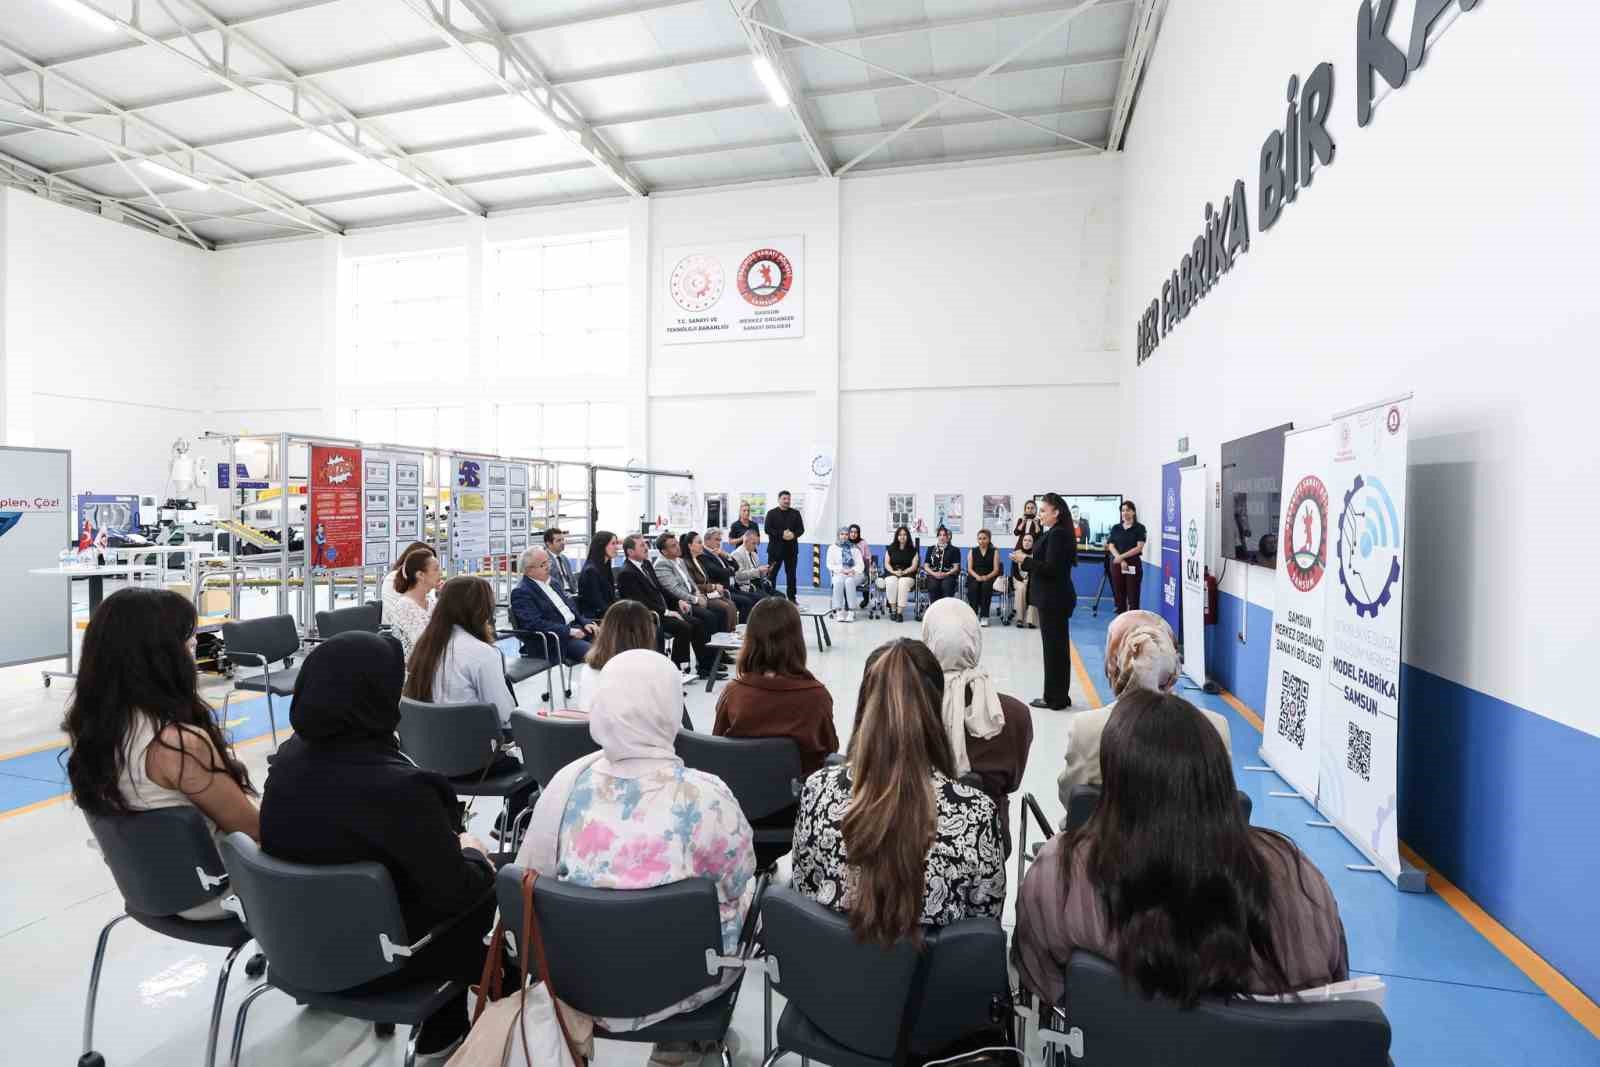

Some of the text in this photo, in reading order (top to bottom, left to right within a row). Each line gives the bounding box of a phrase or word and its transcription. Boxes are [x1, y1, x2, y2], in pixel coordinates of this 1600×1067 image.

[1137, 298, 1159, 367] HER
[1161, 179, 1249, 338] FABRİKA
[1258, 62, 1336, 232] BİR
[1275, 623, 1295, 640] MERKEZ
[1288, 610, 1311, 628] SAMSUN
[1333, 656, 1397, 701] MODEL FABRİKA
[1344, 685, 1378, 716] SAMSUN
